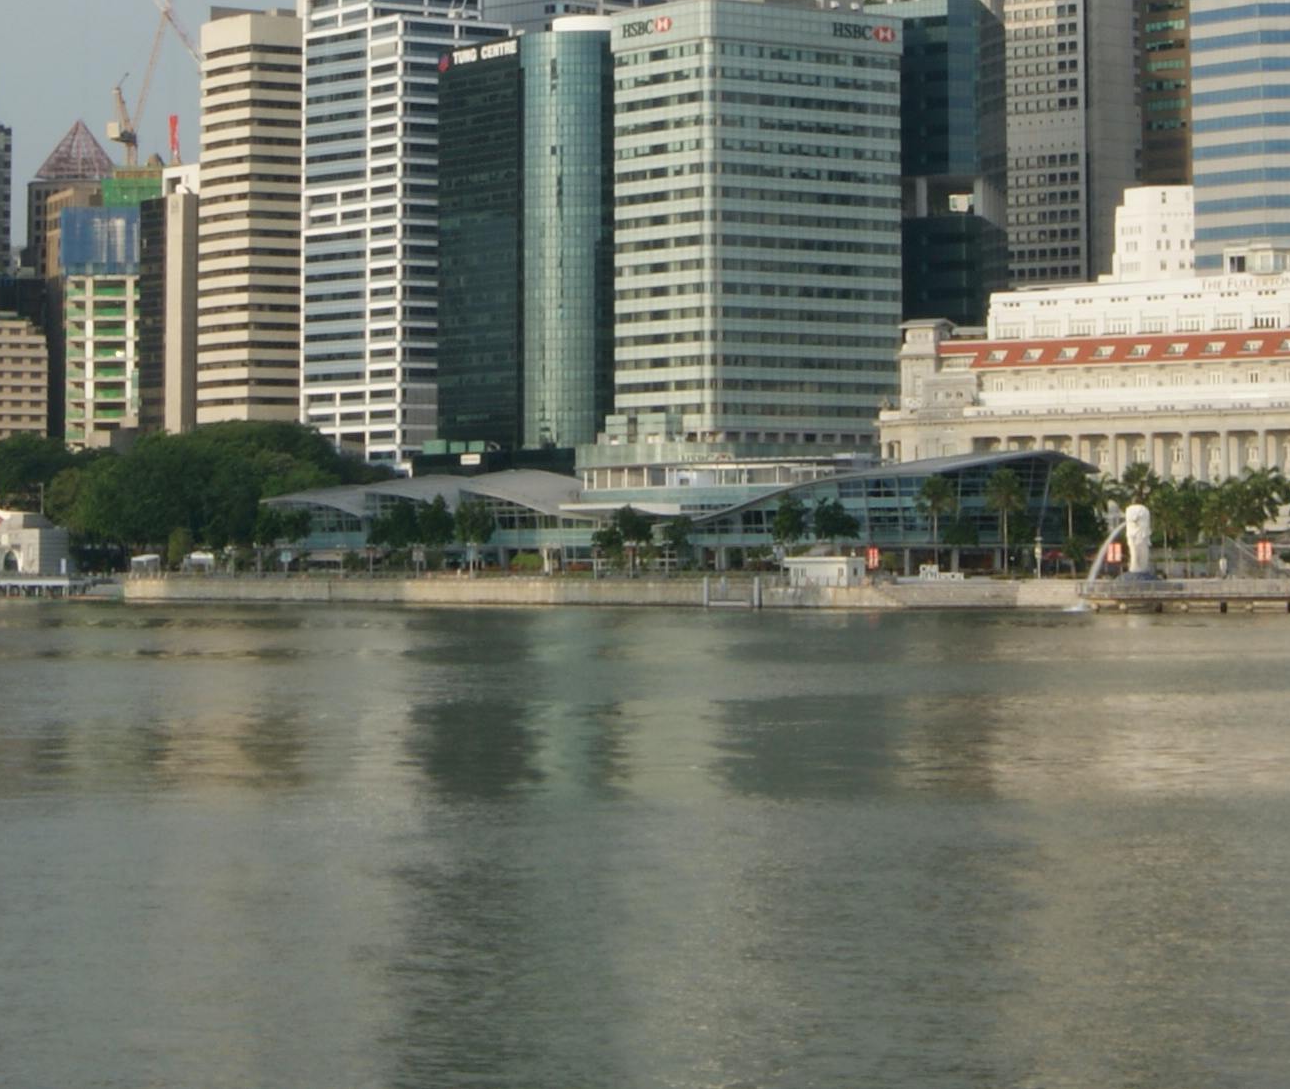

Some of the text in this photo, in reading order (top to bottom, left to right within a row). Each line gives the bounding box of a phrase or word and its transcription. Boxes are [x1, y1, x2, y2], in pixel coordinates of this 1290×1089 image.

[622, 20, 653, 38] HSBC
[832, 22, 872, 41] HSBC
[481, 39, 517, 60] CENTRE
